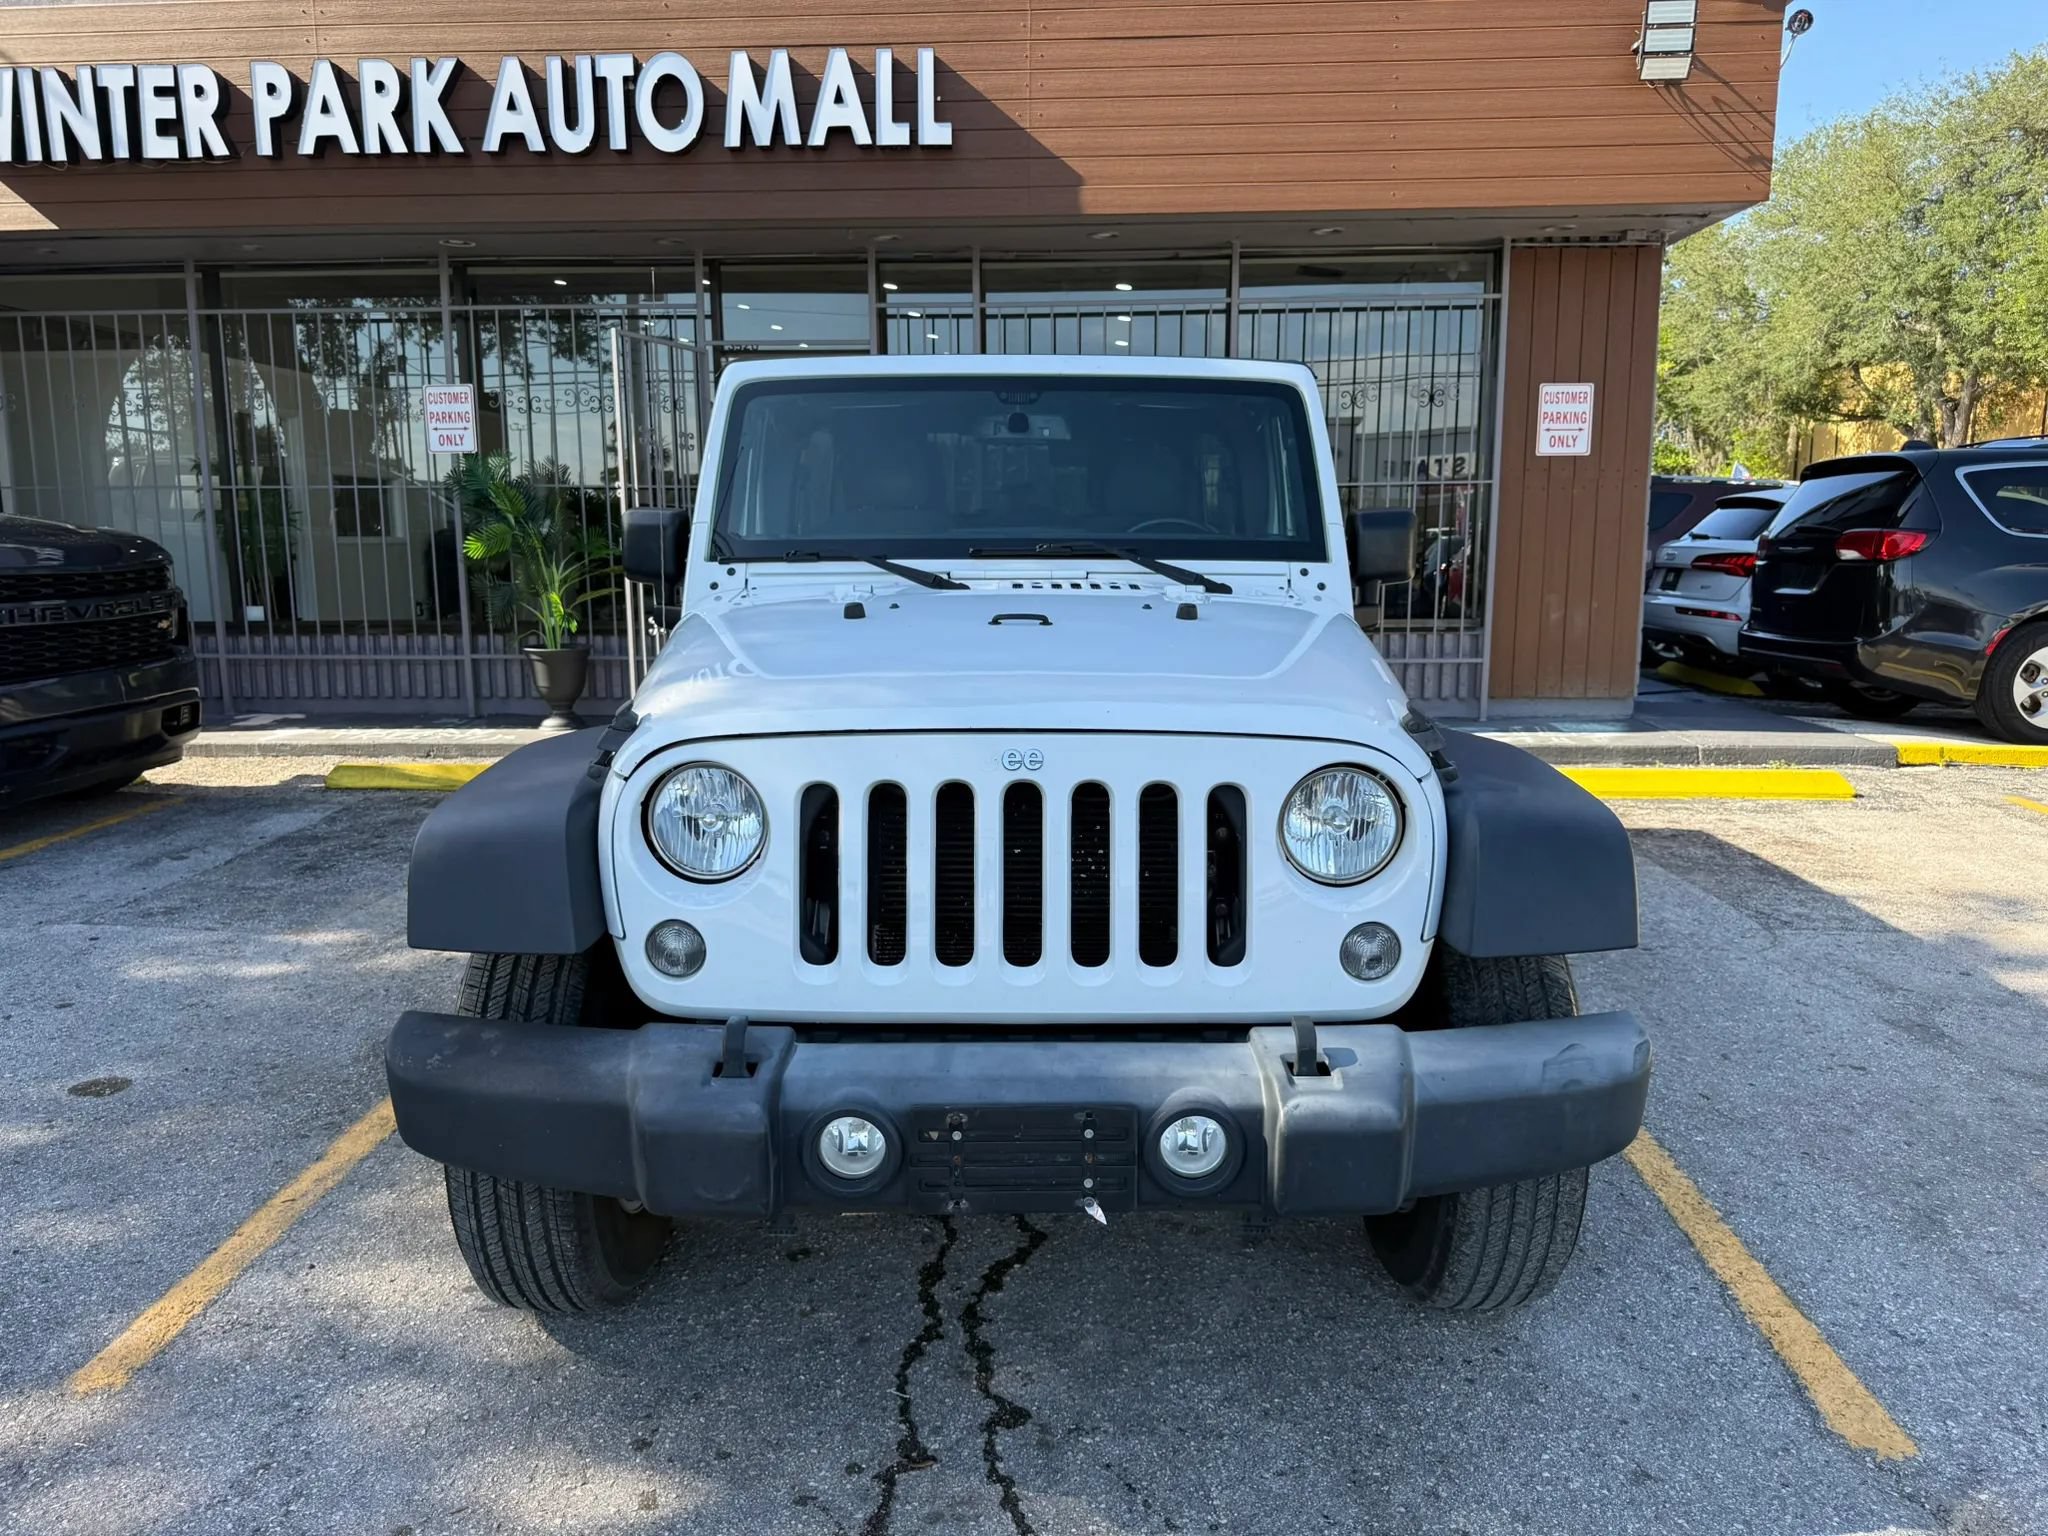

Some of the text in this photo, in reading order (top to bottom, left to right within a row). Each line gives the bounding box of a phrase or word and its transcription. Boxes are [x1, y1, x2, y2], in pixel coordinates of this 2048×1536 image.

[0, 47, 953, 162] INTER PARK AUTO MALL
[427, 391, 470, 405] CUSTOMER
[1543, 391, 1589, 405] CUSTOMER
[428, 410, 471, 425] PARKING
[1542, 411, 1588, 425] PARKING
[438, 433, 465, 447] ONLY
[1549, 434, 1578, 449] ONLY
[0, 593, 174, 624] HEVROLET
